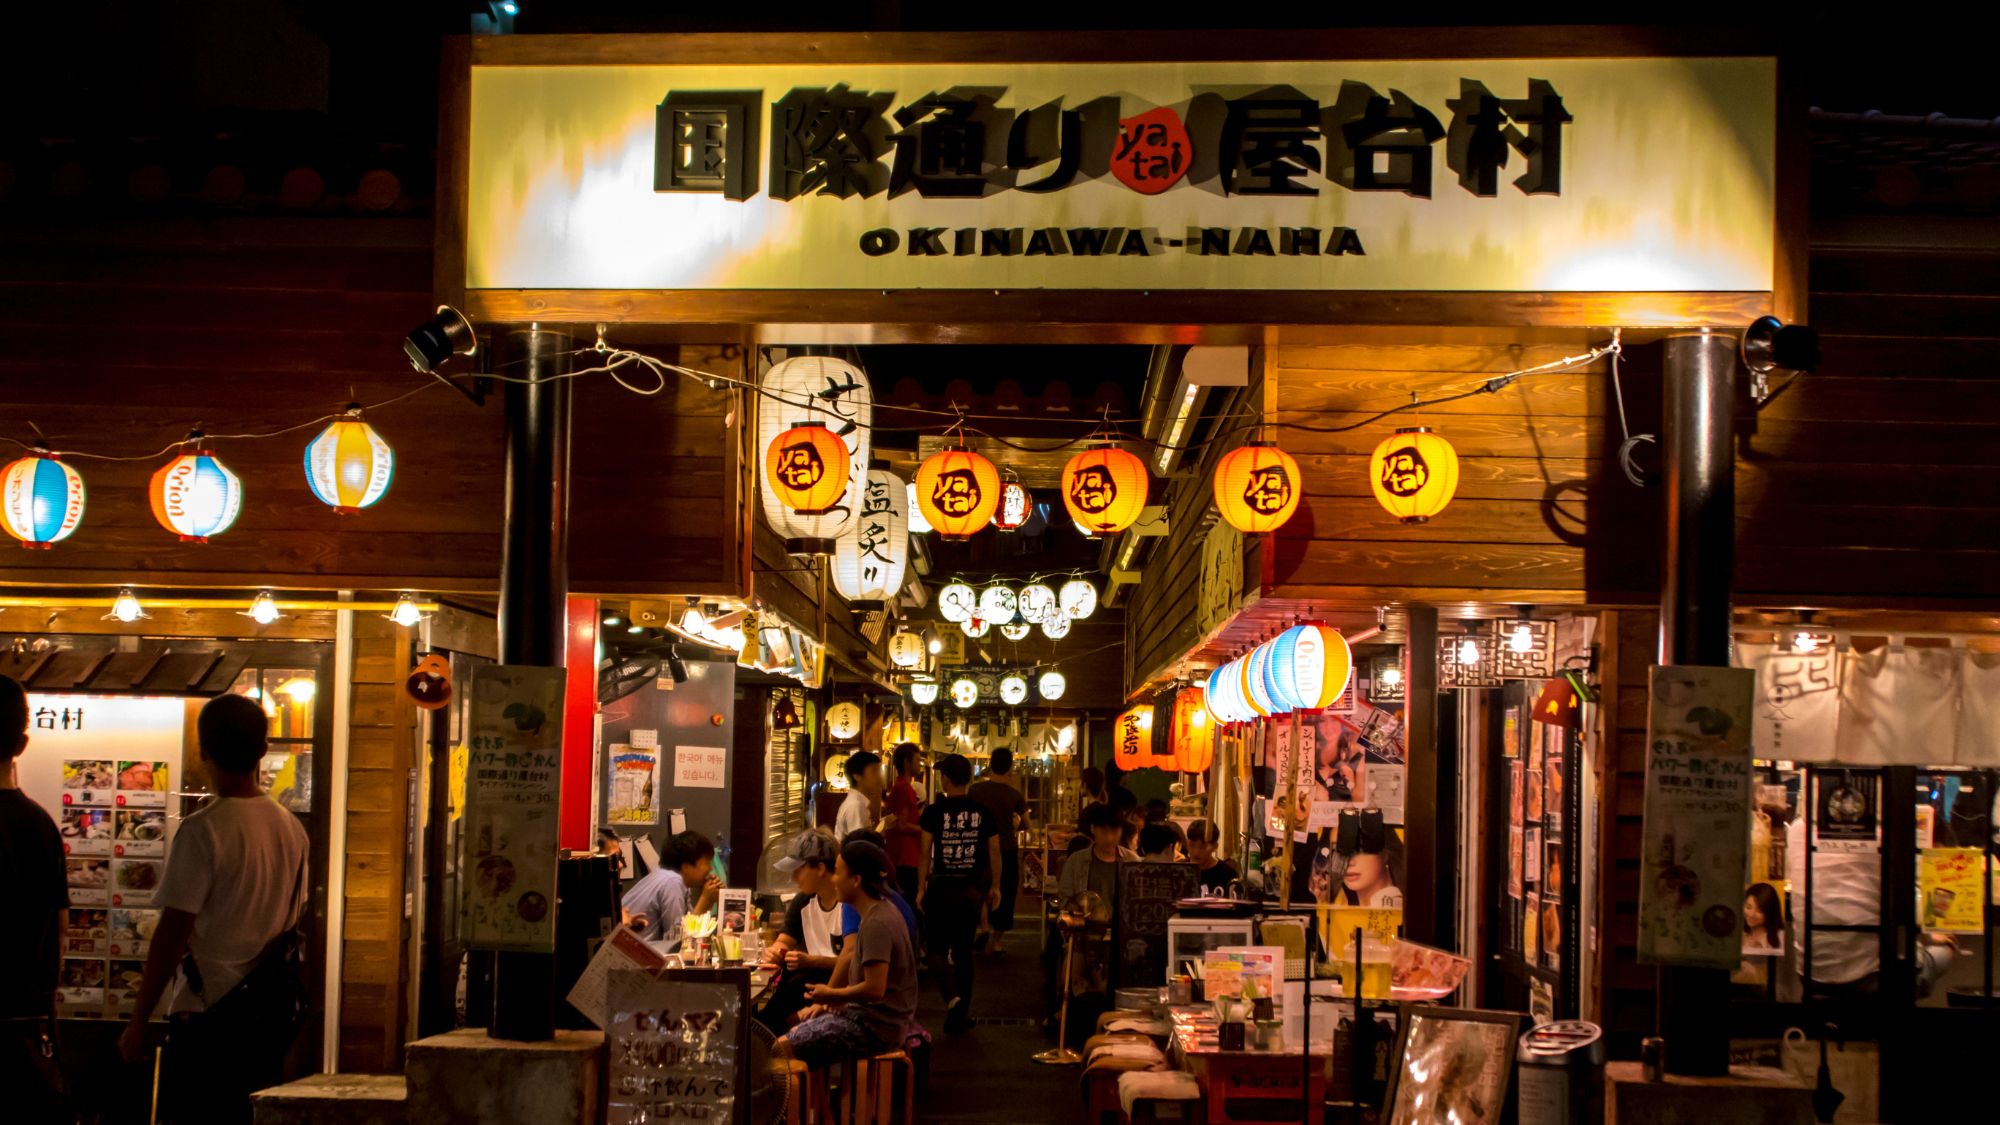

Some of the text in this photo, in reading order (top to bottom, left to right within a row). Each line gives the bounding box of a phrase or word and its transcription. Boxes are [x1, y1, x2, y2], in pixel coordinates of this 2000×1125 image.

[654, 86, 1573, 202] 国際通り 屋台村
[1116, 121, 1168, 162] ya
[1129, 142, 1182, 182] tai
[168, 465, 191, 518] Orion
[35, 706, 83, 731] 台村
